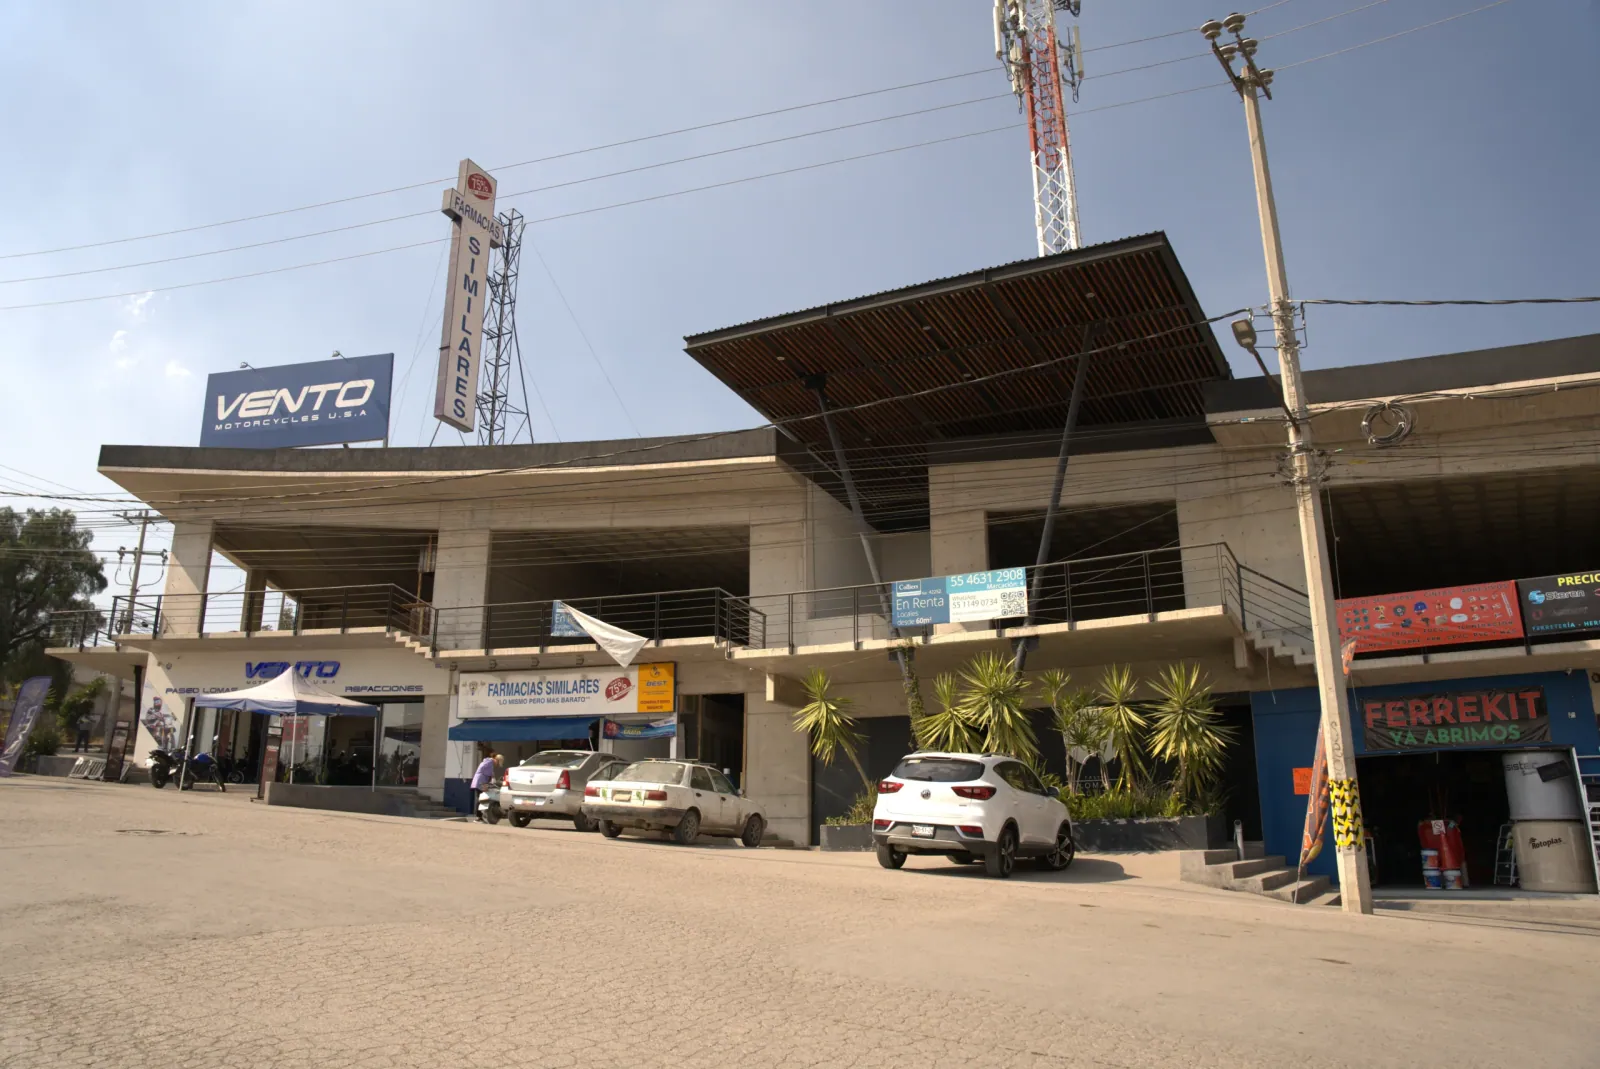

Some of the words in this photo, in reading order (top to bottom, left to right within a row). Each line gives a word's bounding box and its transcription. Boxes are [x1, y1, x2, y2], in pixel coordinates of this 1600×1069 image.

[471, 178, 489, 192] 75%
[454, 196, 501, 240] FARMACIAS
[453, 236, 481, 418] SIMILARES
[217, 379, 375, 421] VENTO
[214, 414, 320, 431] MOTORCYCLES
[950, 575, 964, 587] 55
[966, 571, 992, 585] 4631
[996, 568, 1024, 582] 2908
[898, 583, 919, 591] Colliers
[896, 598, 910, 611] En
[912, 597, 944, 609] Renta
[952, 601, 961, 609] 55
[963, 599, 980, 608] 1149
[980, 598, 998, 607] 0734
[896, 610, 919, 618] Locales
[245, 661, 340, 678] VENTO
[344, 685, 424, 693] REFACCIONES
[487, 681, 543, 697] FARMACIAS
[545, 679, 600, 695] SIMILARES
[608, 680, 627, 695] 75%
[1364, 692, 1541, 729] FERREKIT
[1388, 730, 1419, 746] YA
[1423, 724, 1521, 745] ABRIMOS
[1531, 837, 1562, 850] Rotoplas
